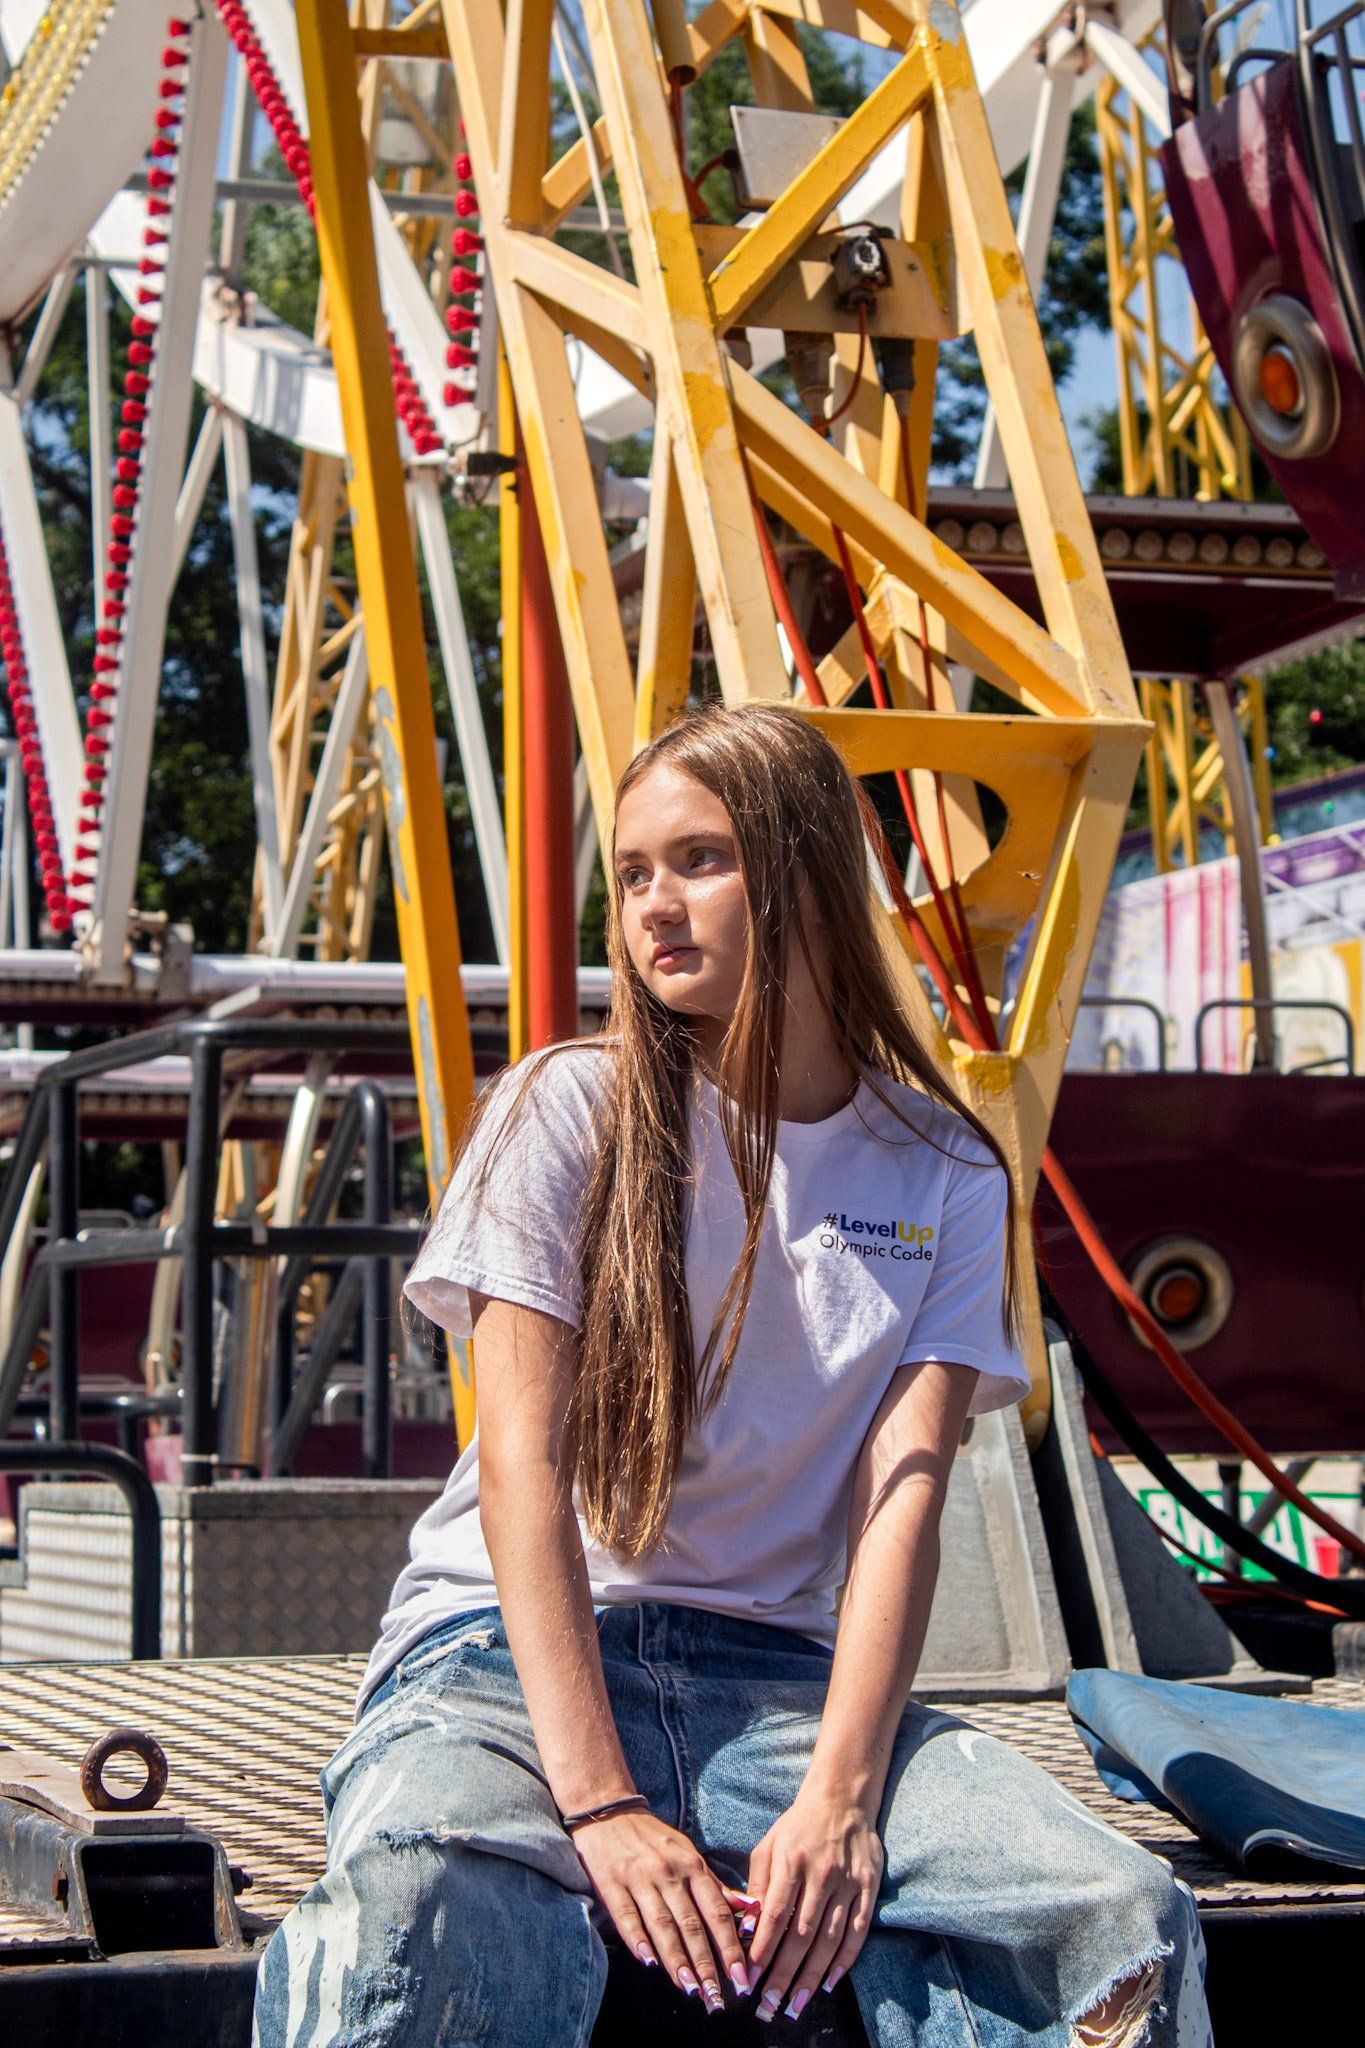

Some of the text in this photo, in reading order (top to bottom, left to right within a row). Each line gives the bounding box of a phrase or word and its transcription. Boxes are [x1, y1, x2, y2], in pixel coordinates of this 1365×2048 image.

[823, 1213, 935, 1246] #LevelUp
[820, 1234, 933, 1261] Olympic Code
